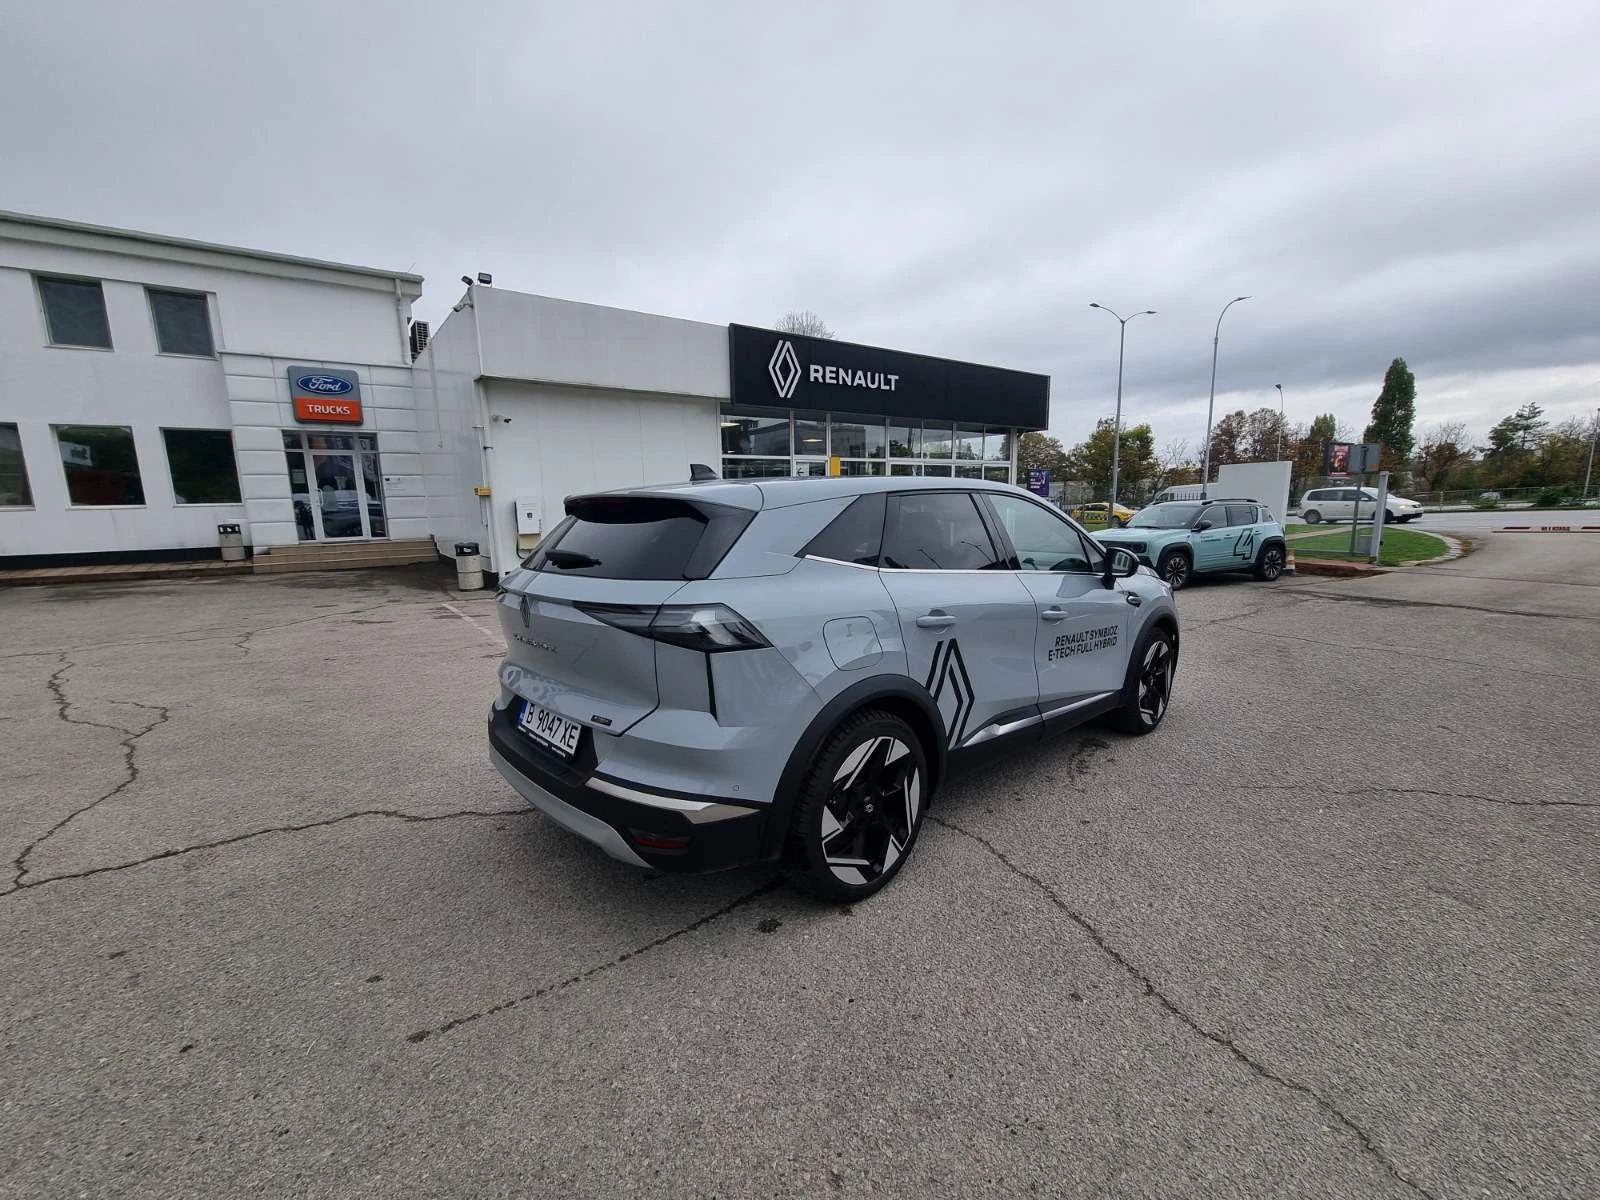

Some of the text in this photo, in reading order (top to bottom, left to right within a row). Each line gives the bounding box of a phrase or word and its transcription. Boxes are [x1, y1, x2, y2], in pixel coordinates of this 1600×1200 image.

[308, 377, 341, 391] Ford
[809, 364, 899, 391] RENAULT
[306, 404, 351, 415] TRUCKS
[1055, 625, 1119, 647] RENAULT SYMBIOZ
[1048, 636, 1118, 661] E-TECH FULL HYBRID
[526, 702, 536, 724] B
[536, 708, 563, 739] 9047
[560, 720, 579, 749] XE
